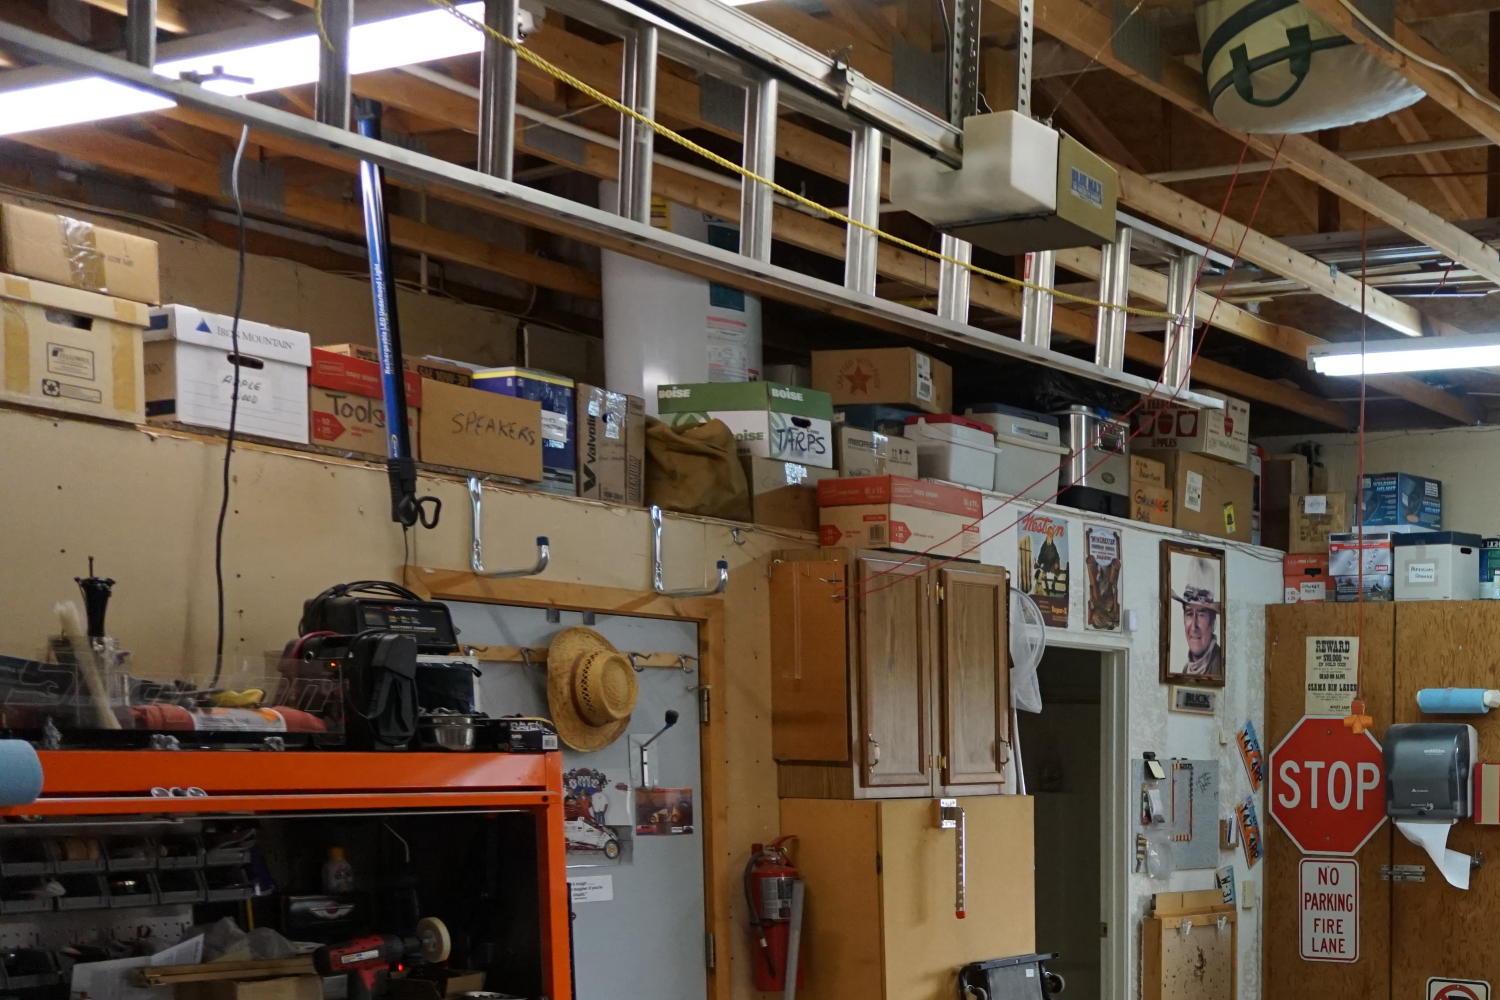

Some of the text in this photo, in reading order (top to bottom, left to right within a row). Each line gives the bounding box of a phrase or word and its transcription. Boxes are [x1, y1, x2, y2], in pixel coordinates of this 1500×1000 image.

[241, 331, 293, 350] MOUNTAIN
[222, 374, 262, 391] APLE
[451, 411, 536, 446] SPEAKERS
[776, 426, 827, 455] TARPS
[1315, 640, 1350, 653] REWARD
[1278, 760, 1380, 810] STOP
[1318, 867, 1339, 886] NO
[1304, 893, 1353, 912] PARKING
[1313, 918, 1344, 935] FIRE
[1311, 938, 1346, 954] LANE
